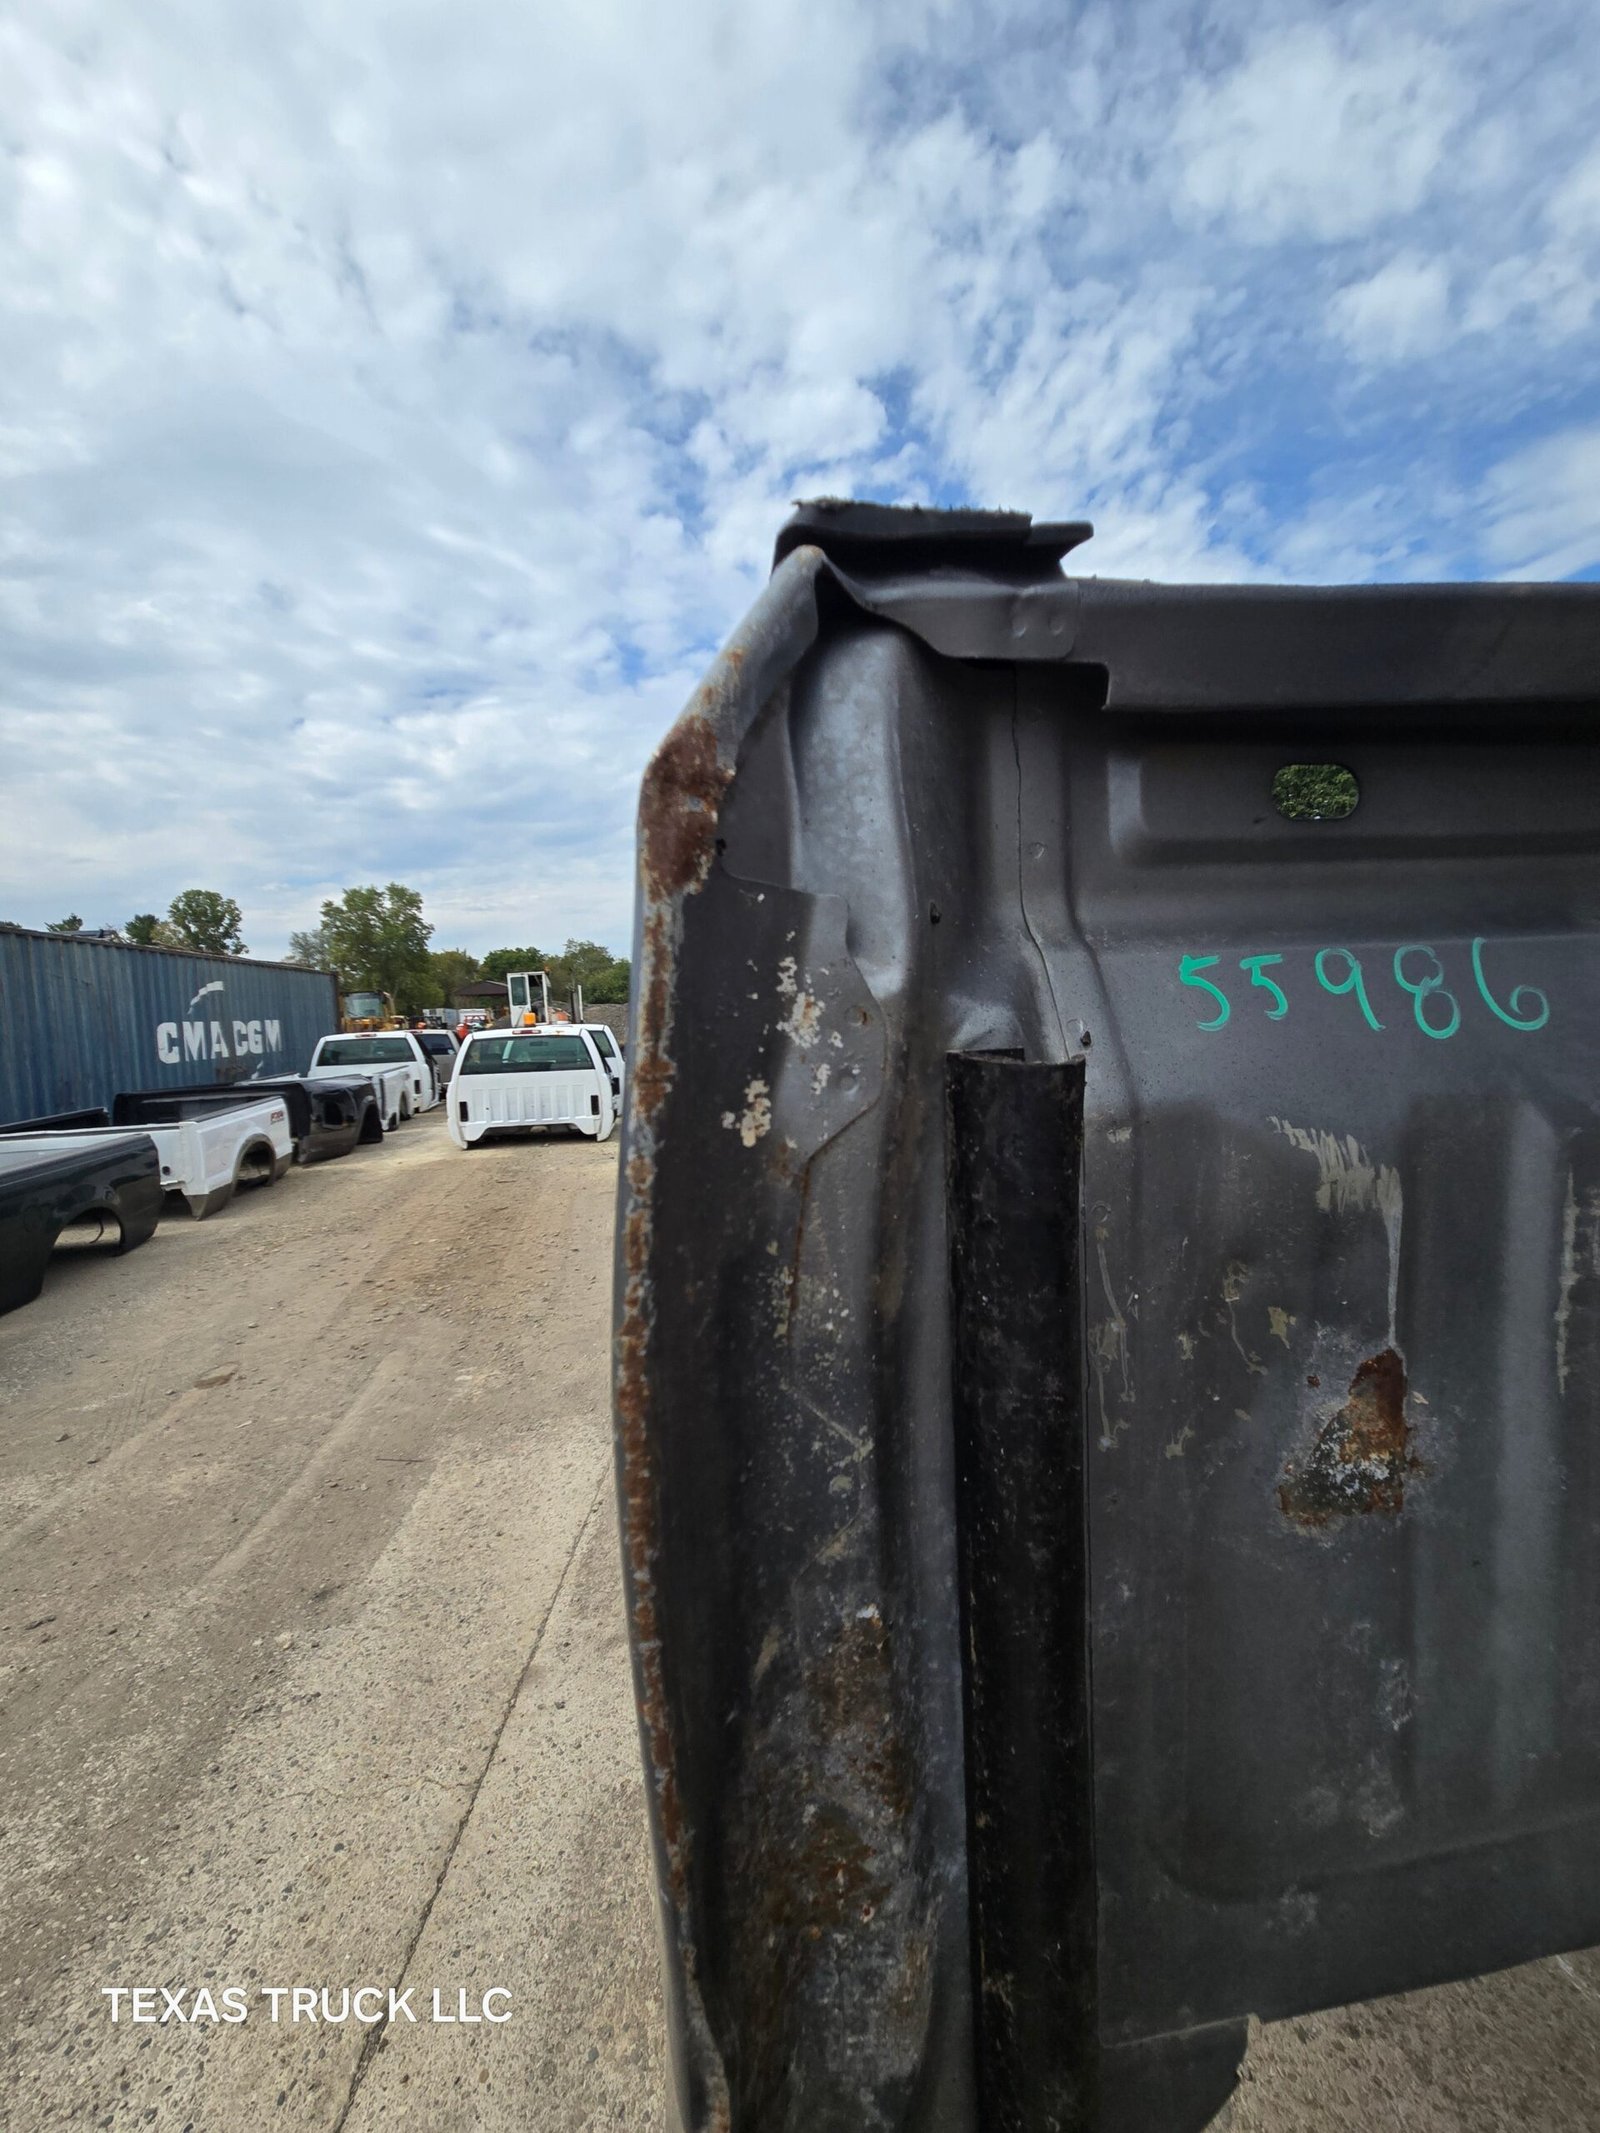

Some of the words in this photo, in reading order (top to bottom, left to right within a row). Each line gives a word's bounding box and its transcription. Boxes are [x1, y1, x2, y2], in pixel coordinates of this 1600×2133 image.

[1178, 937, 1550, 1039] 55986
[156, 1021, 229, 1064] CMA
[232, 1019, 282, 1056] CGM
